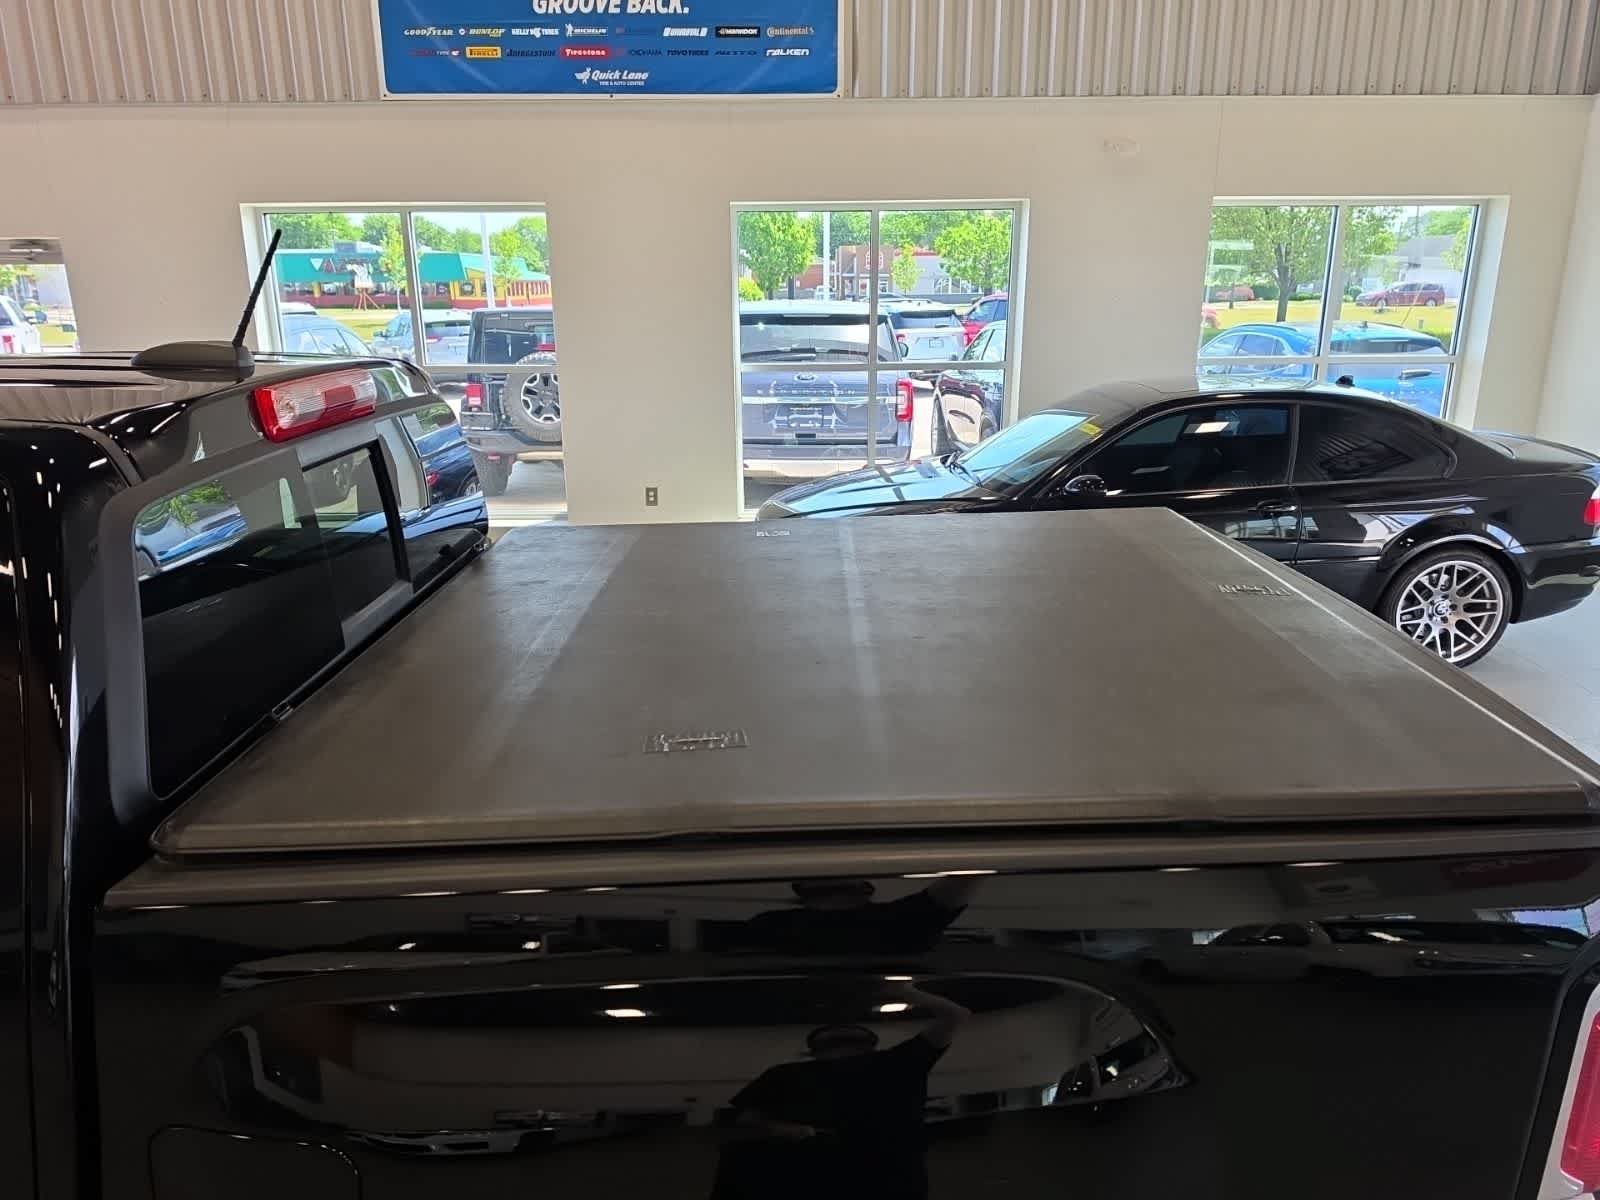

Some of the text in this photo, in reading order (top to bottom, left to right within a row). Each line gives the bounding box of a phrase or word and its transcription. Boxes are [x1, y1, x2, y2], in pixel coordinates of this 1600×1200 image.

[532, 0, 689, 14] GROOVE BACK.
[403, 26, 454, 36] GOODYEAR
[565, 48, 606, 57] Firestone
[591, 70, 649, 80] Quick Lane
